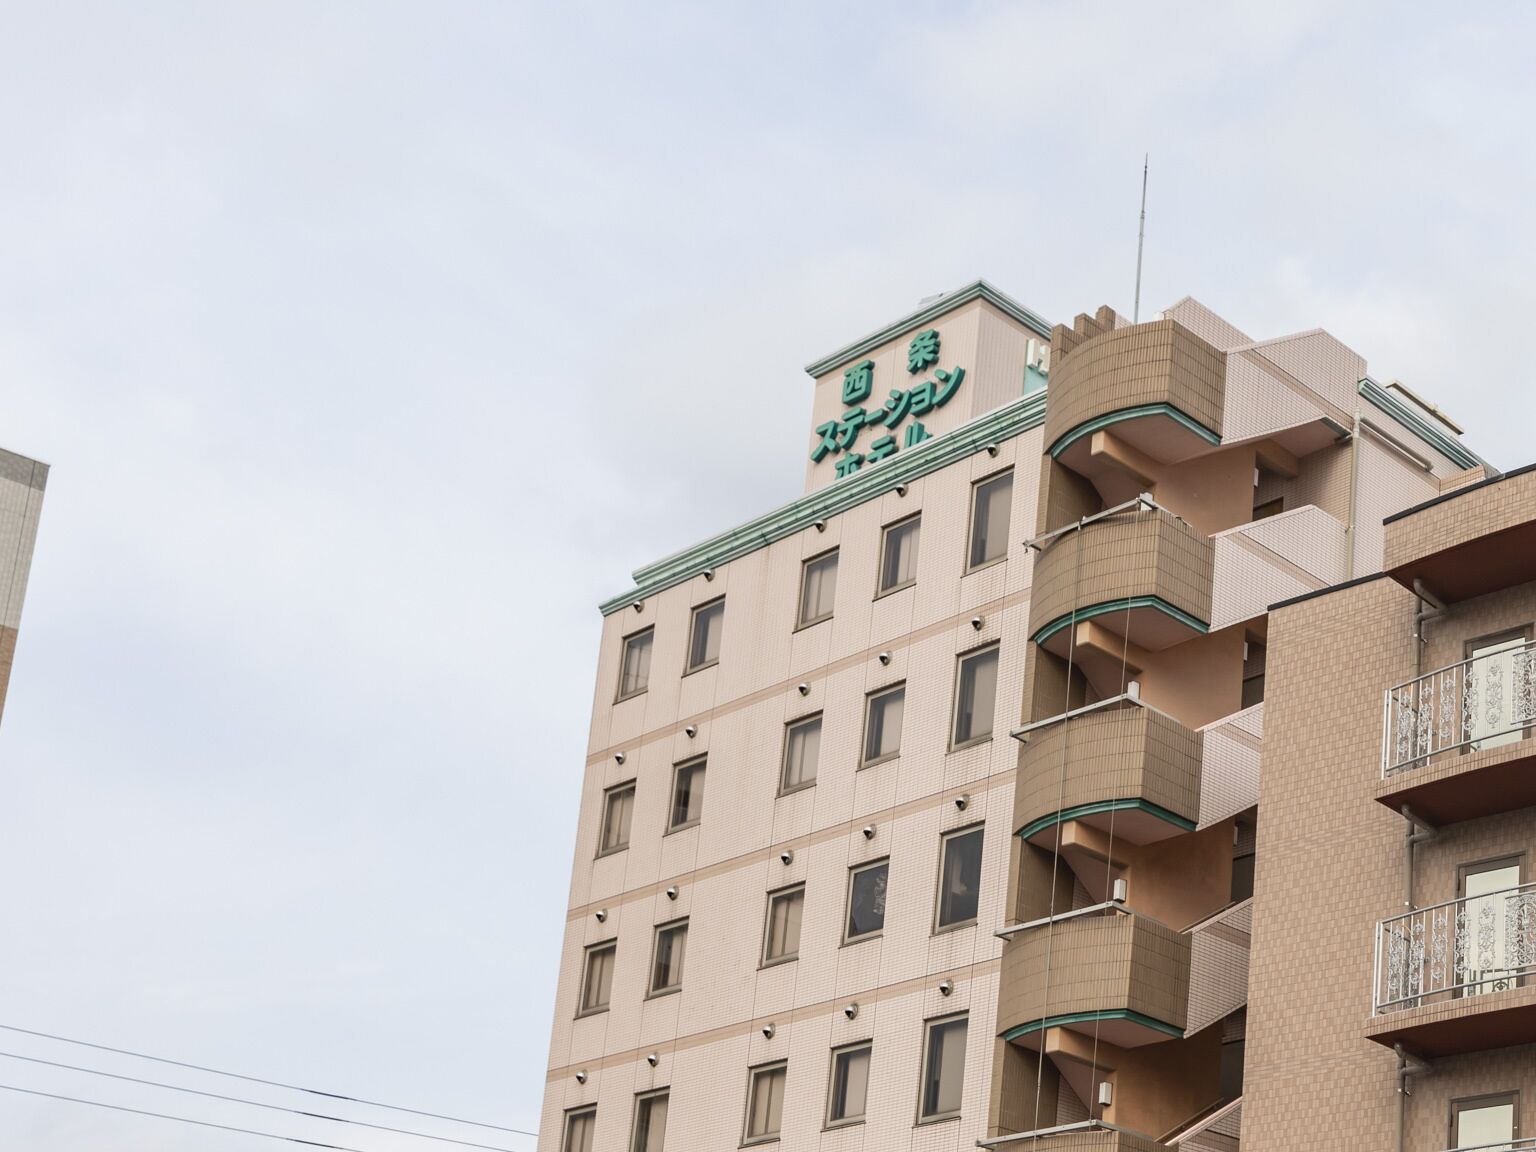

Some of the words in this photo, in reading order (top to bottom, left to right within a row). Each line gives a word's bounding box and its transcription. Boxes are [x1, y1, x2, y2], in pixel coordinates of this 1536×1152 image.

[842, 328, 941, 406] 西条
[810, 366, 966, 464] ステーション
